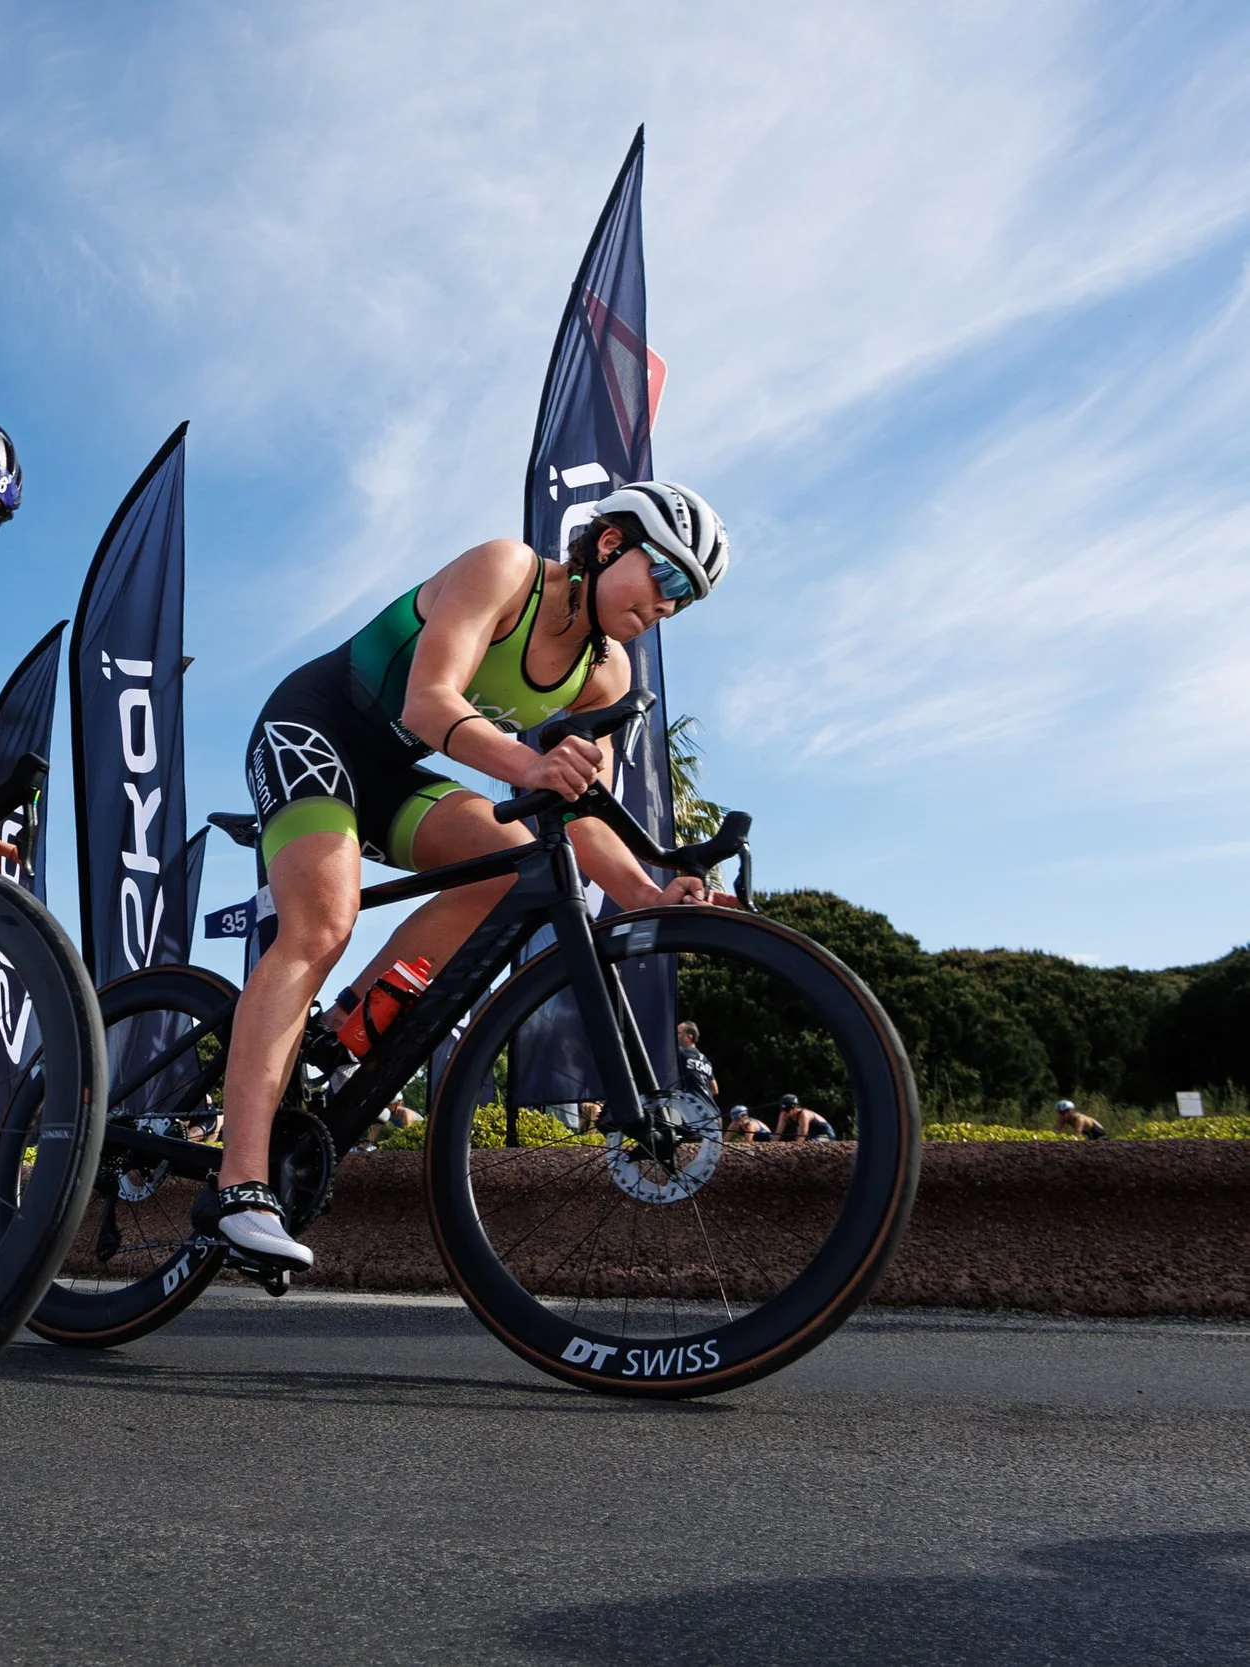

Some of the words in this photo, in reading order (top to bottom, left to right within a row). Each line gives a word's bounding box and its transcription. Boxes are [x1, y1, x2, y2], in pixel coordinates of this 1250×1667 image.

[252, 736, 278, 815] kiwami
[221, 909, 247, 934] 35
[162, 1251, 190, 1296] DT
[560, 1336, 619, 1371] DT
[621, 1339, 721, 1376] SWISS
